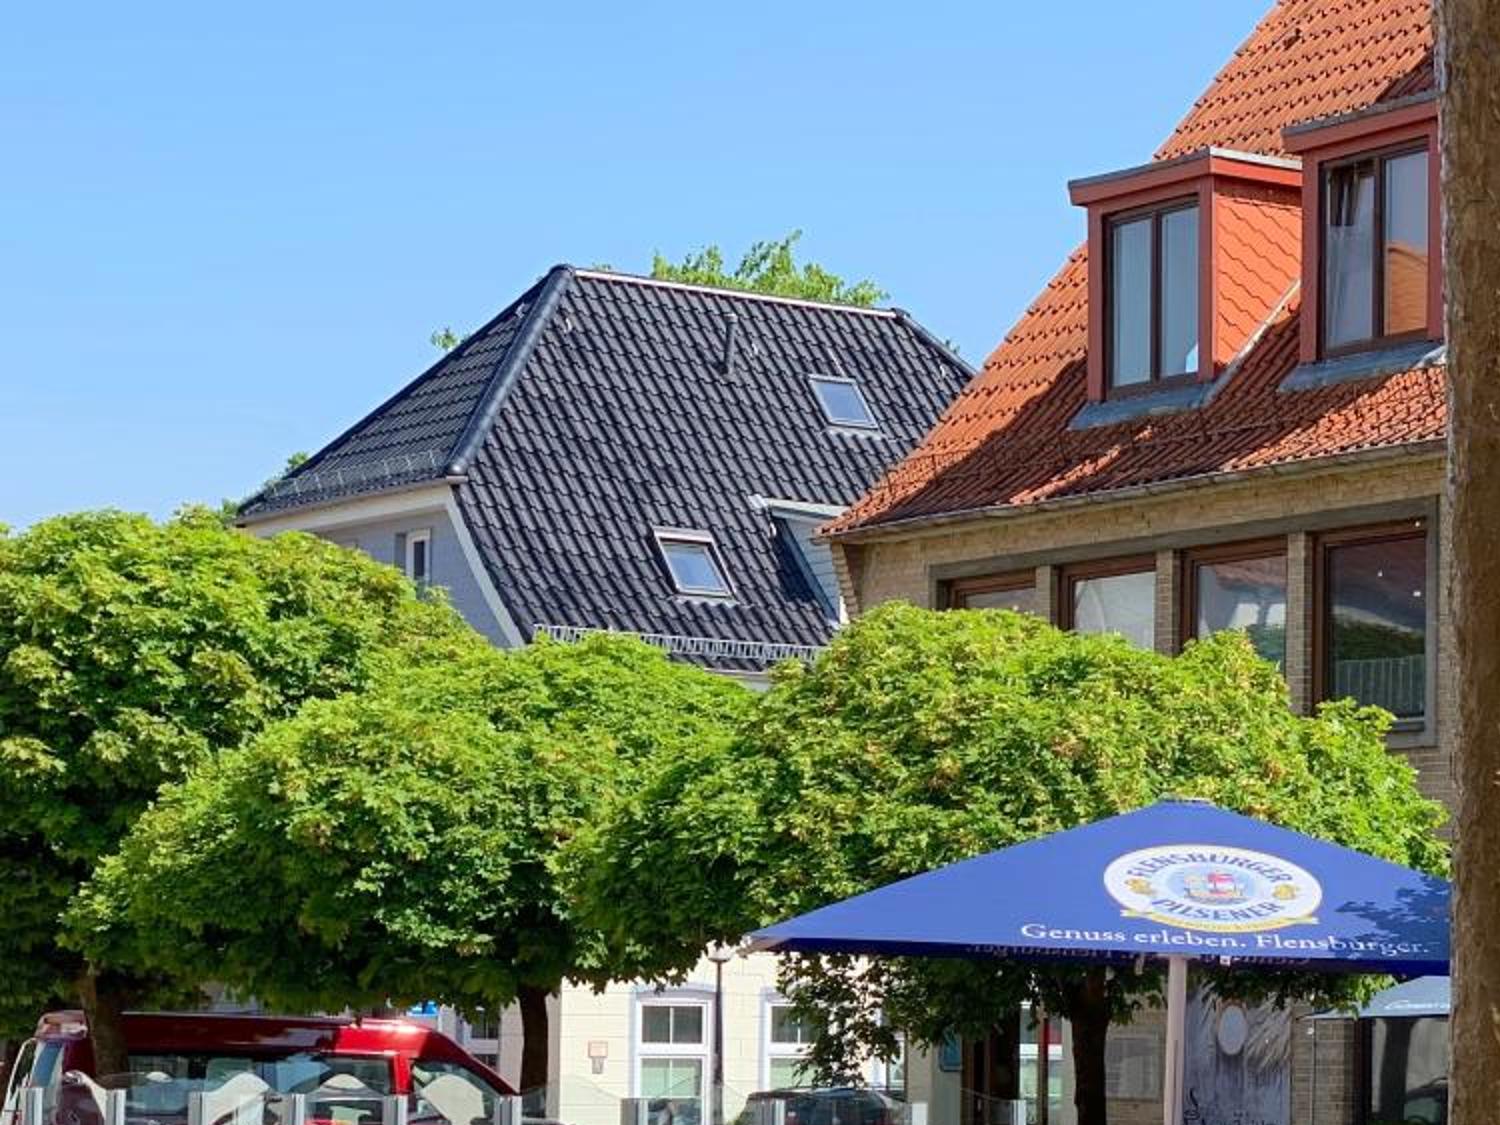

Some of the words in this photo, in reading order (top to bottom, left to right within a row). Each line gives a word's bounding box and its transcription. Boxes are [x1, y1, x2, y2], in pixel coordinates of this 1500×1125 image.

[1127, 853, 1293, 883] FLENSBURGER
[1151, 899, 1286, 921] PILSENER
[1020, 923, 1125, 942] Genuss
[1134, 930, 1246, 948] erleben.
[1256, 935, 1428, 957] Flensburger.
